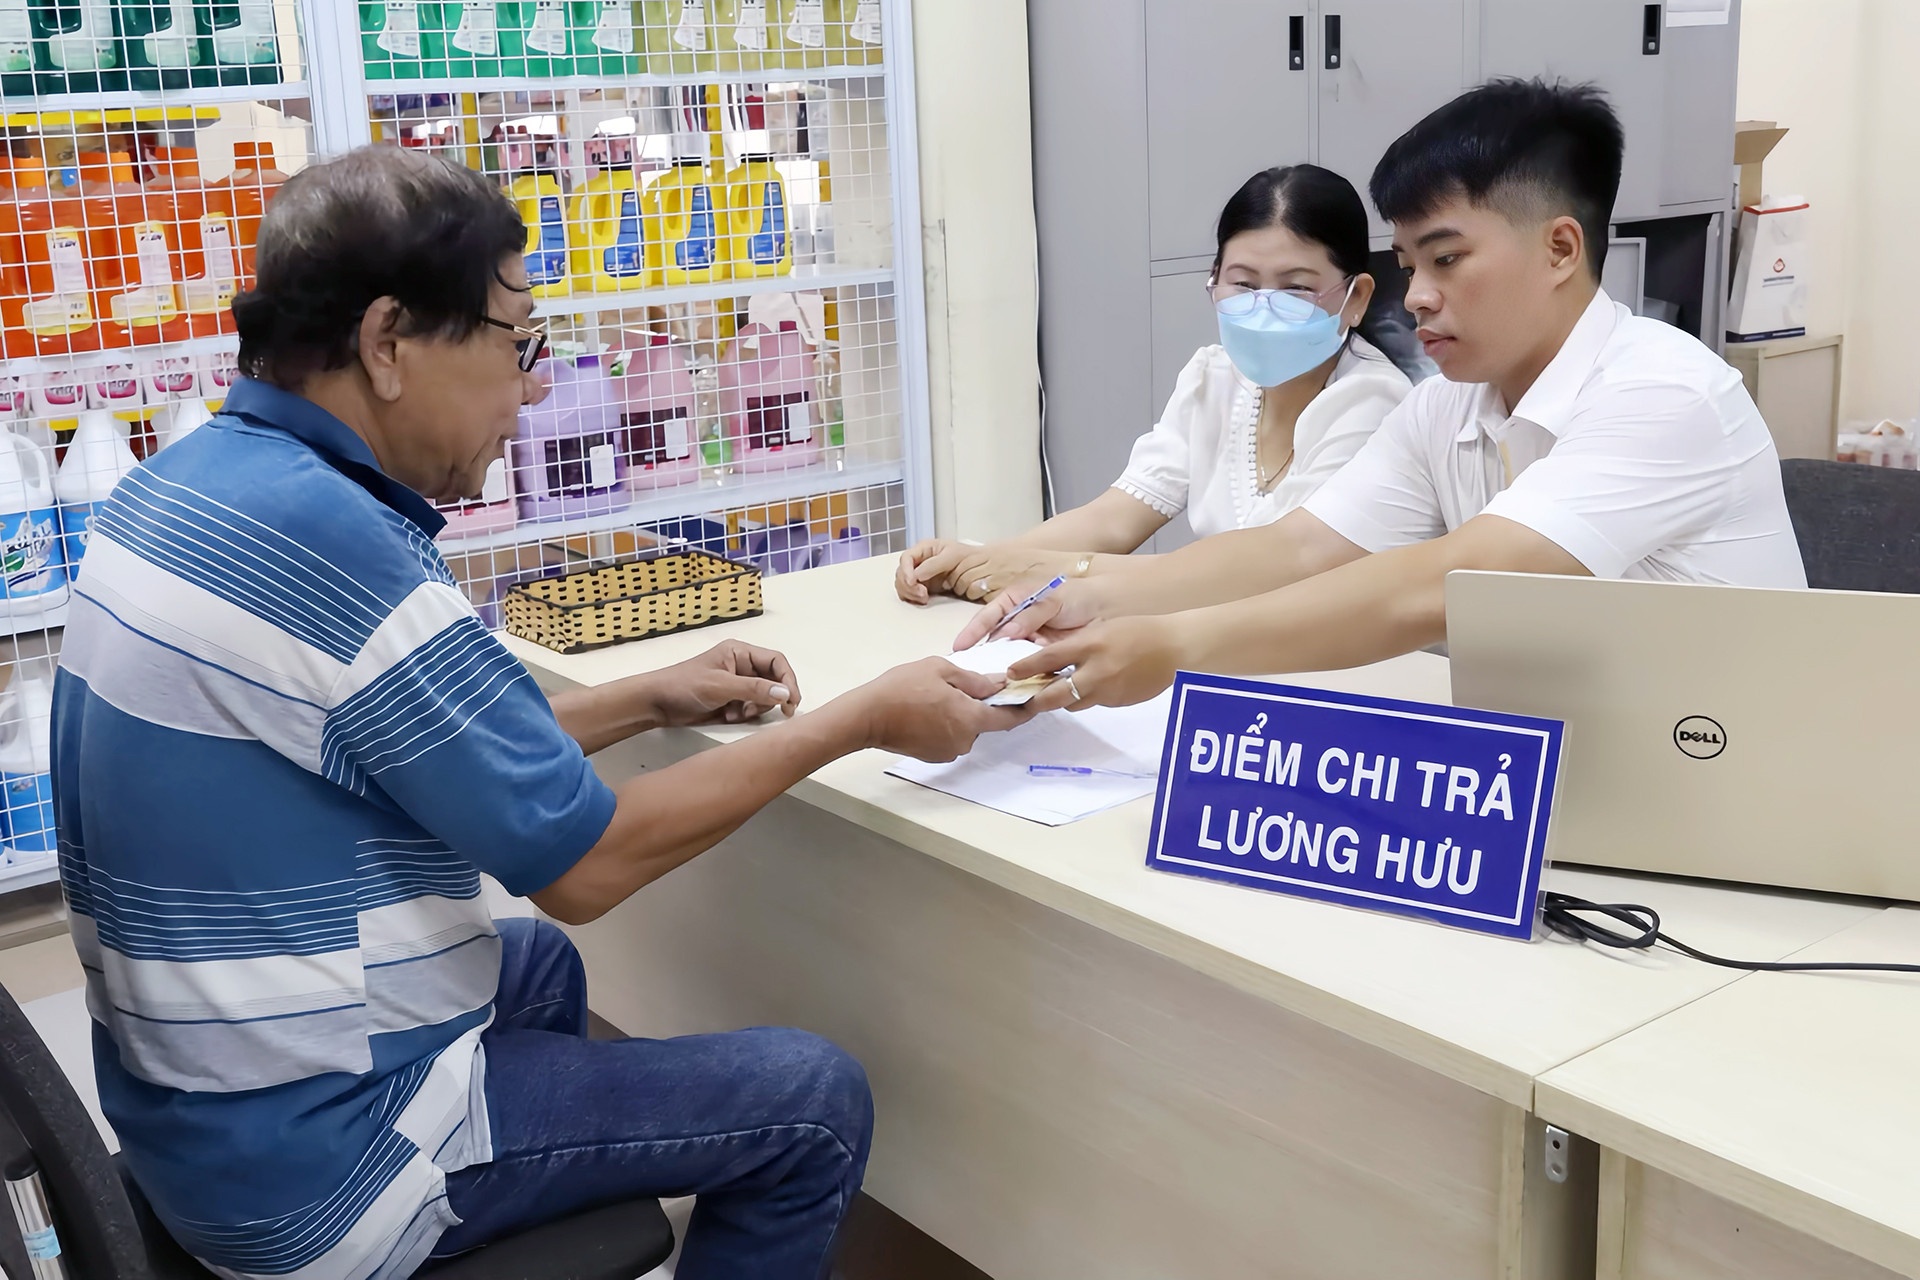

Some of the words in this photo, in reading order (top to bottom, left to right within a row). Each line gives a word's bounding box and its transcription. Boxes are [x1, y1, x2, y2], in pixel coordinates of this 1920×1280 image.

[1189, 712, 1303, 787] ĐIỂM
[1316, 747, 1400, 803] CHI
[1415, 753, 1514, 821] TRẢ
[1679, 730, 1721, 744] DELL
[1197, 804, 1360, 874] LƯƠNG
[1375, 833, 1482, 895] HƯU
